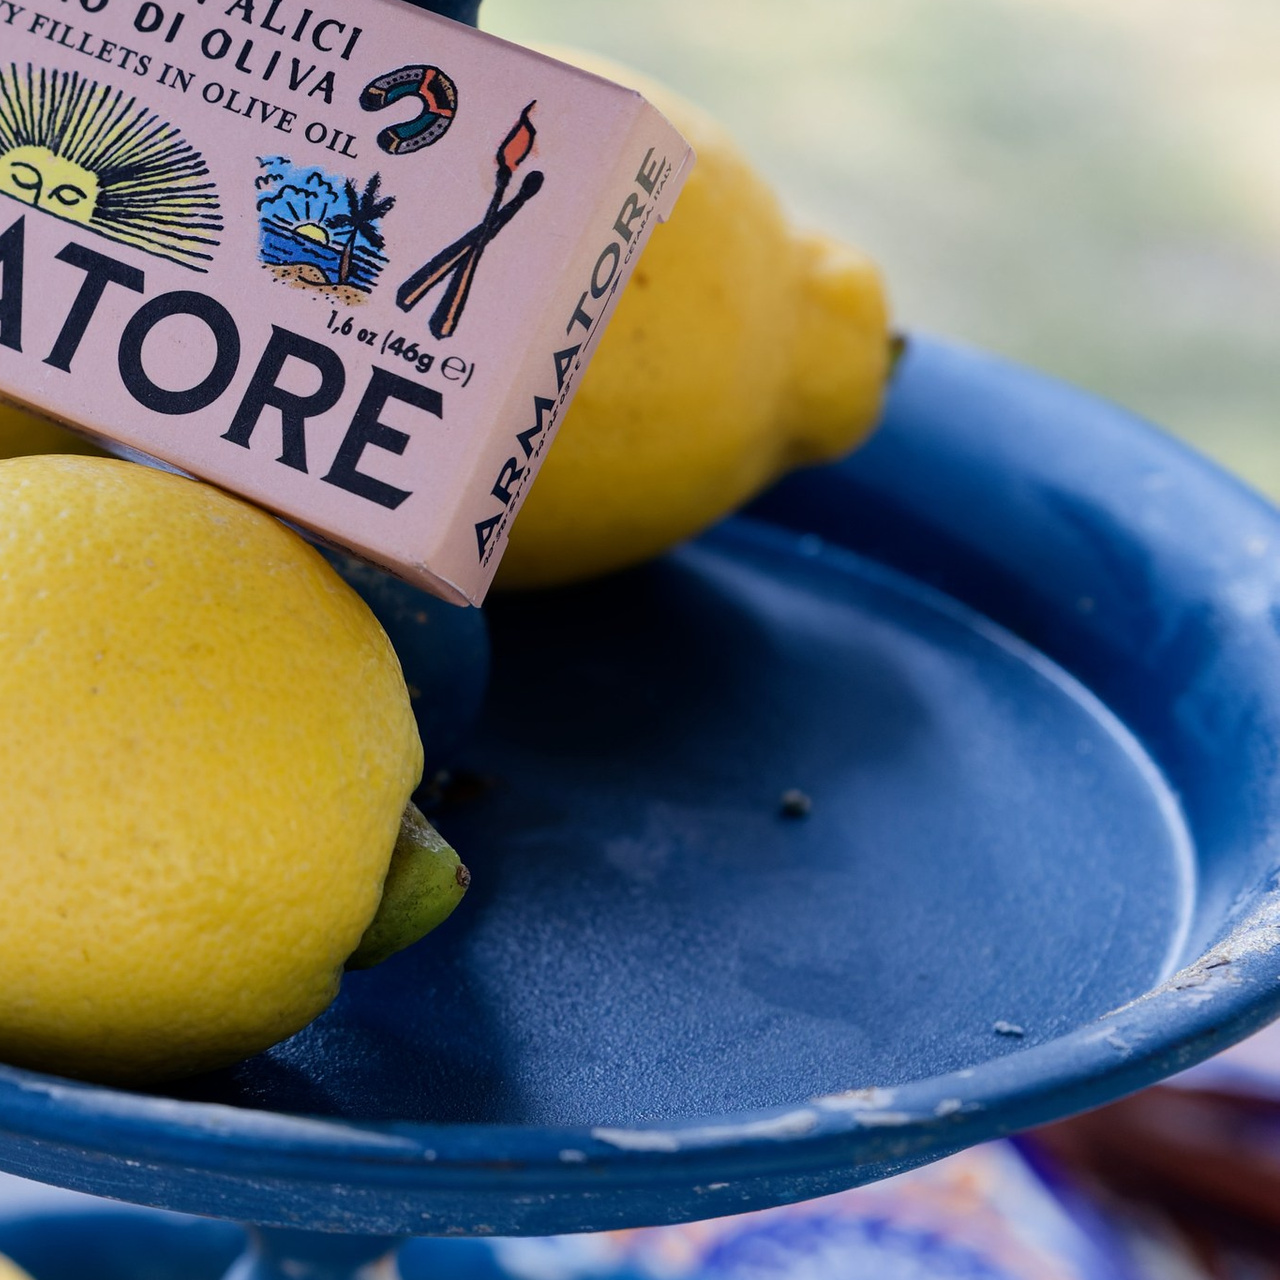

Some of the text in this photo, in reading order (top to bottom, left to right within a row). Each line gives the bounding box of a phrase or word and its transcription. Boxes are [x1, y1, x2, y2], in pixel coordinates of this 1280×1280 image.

[27, 13, 153, 76] FILLETS
[156, 63, 196, 93] IN
[202, 82, 298, 133] OLIVE
[305, 122, 359, 159] OIL
[133, 1, 185, 43] DI
[201, 28, 336, 104] OLIVA
[653, 162, 672, 201] ITALY
[326, 309, 354, 335] 1,6
[357, 328, 378, 346] oz
[380, 329, 435, 373] (46g
[475, 147, 666, 565] ARMATORE
